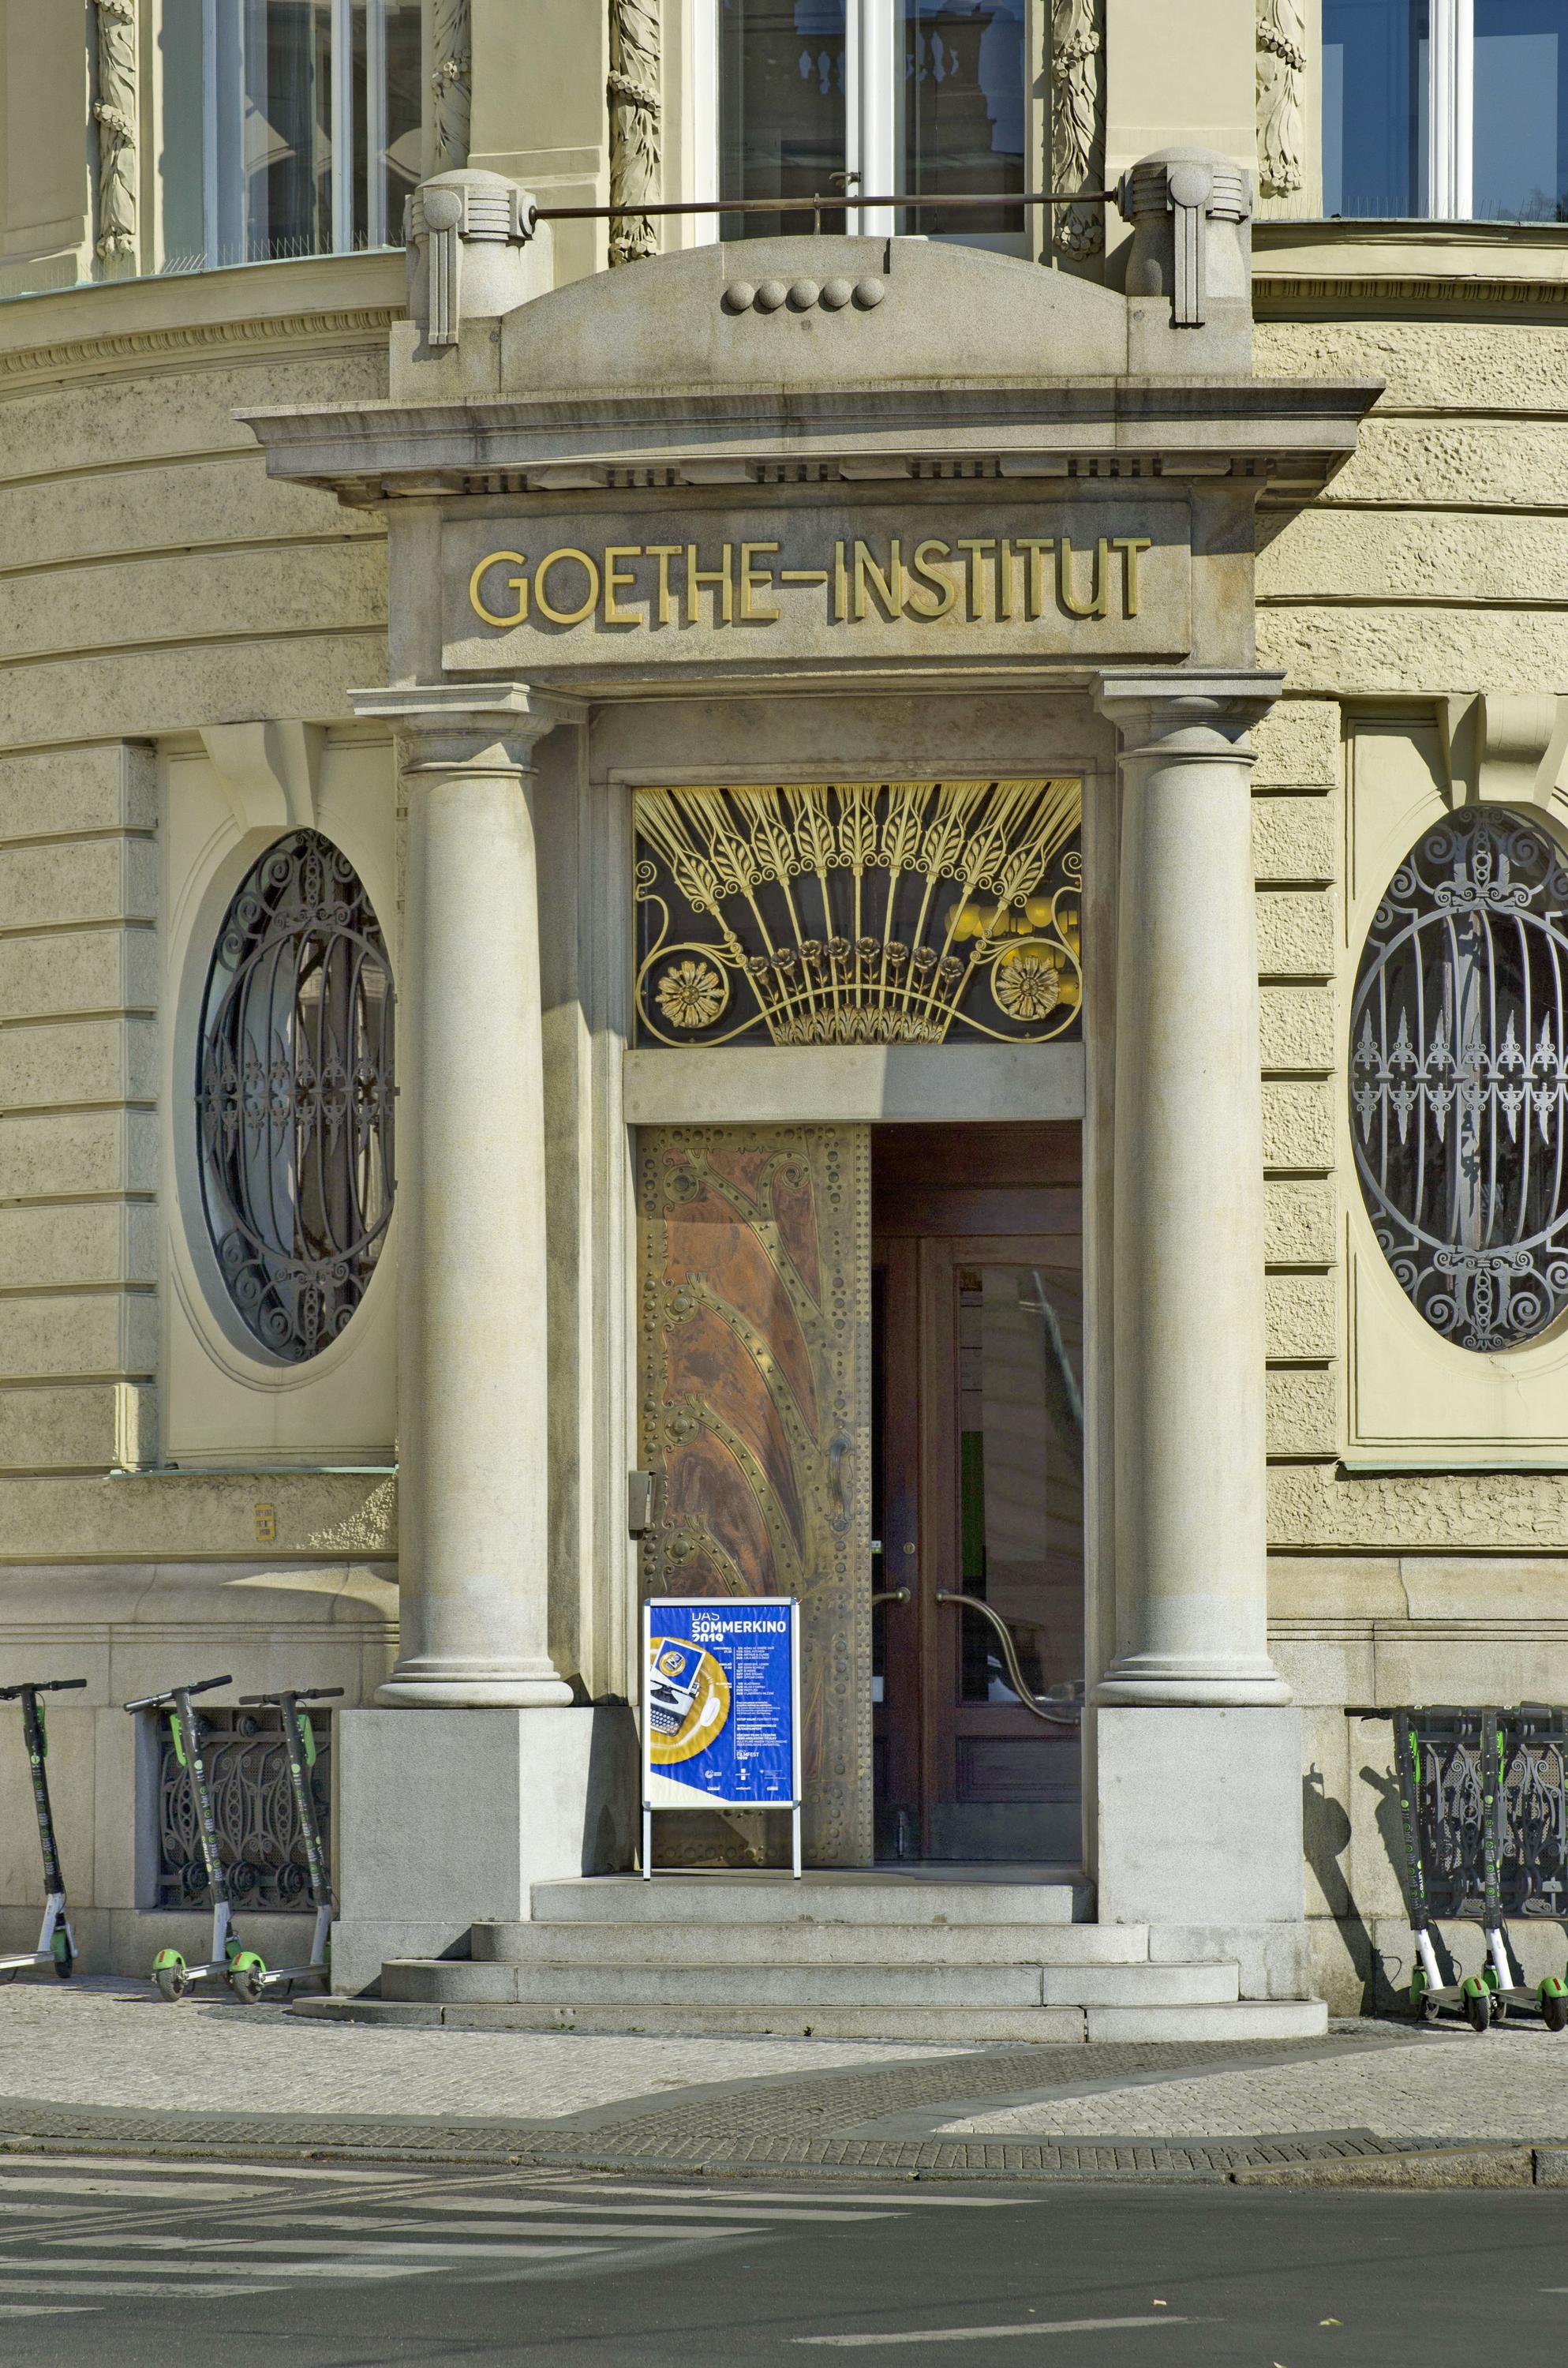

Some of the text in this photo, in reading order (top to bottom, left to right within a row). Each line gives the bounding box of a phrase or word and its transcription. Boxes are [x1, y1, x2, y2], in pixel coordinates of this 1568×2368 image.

[469, 538, 1151, 628] GOETHE-INSTITUT
[692, 1613, 720, 1621] DAS
[692, 1621, 786, 1633] SOMMERKINO
[691, 1633, 724, 1643] 2019
